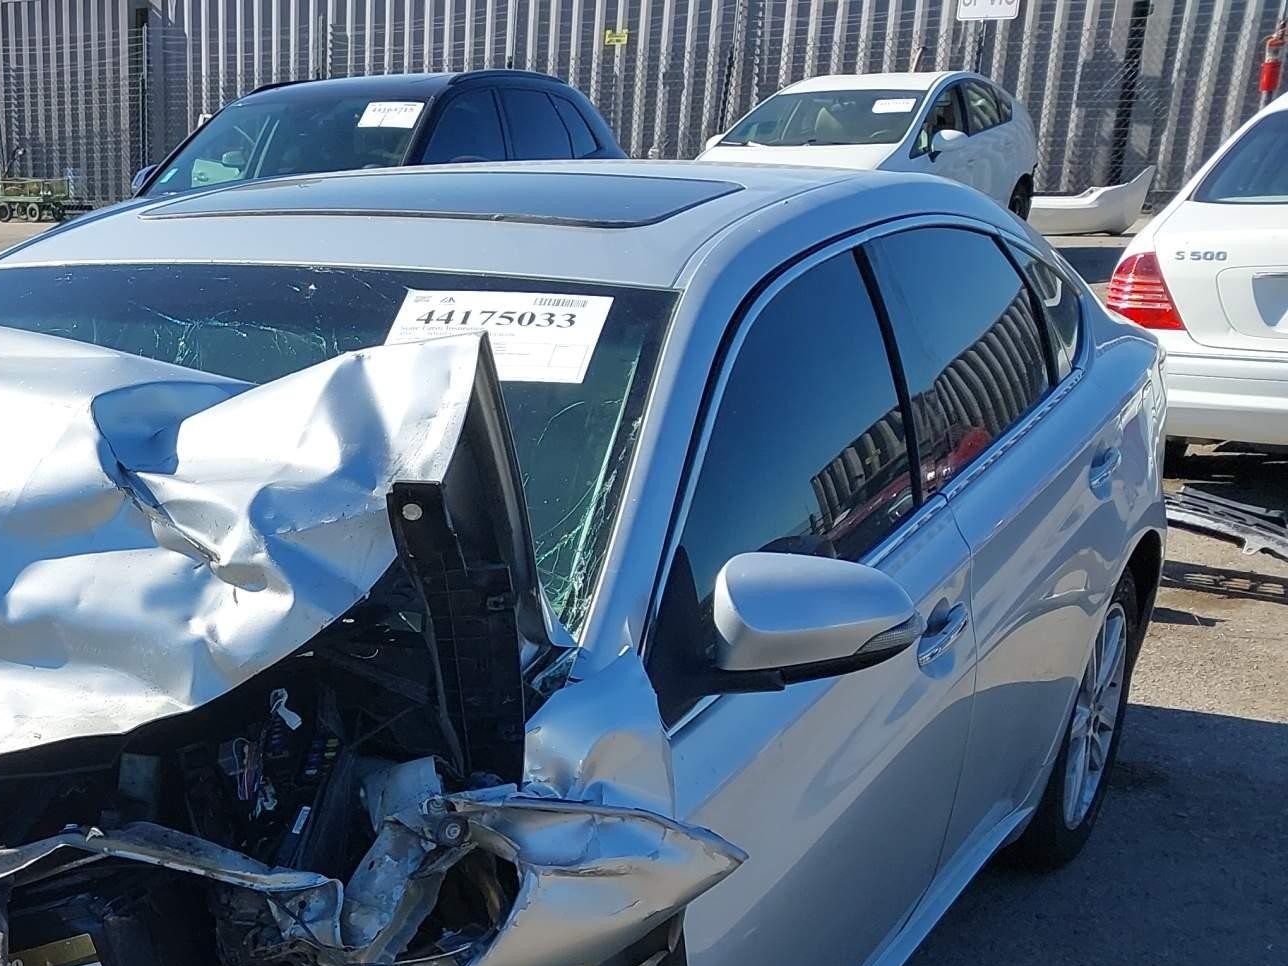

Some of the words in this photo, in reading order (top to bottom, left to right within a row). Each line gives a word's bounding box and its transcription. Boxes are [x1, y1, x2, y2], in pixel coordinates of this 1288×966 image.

[1175, 251, 1185, 261] S
[1189, 251, 1228, 261] 500
[415, 308, 576, 329] 44175033
